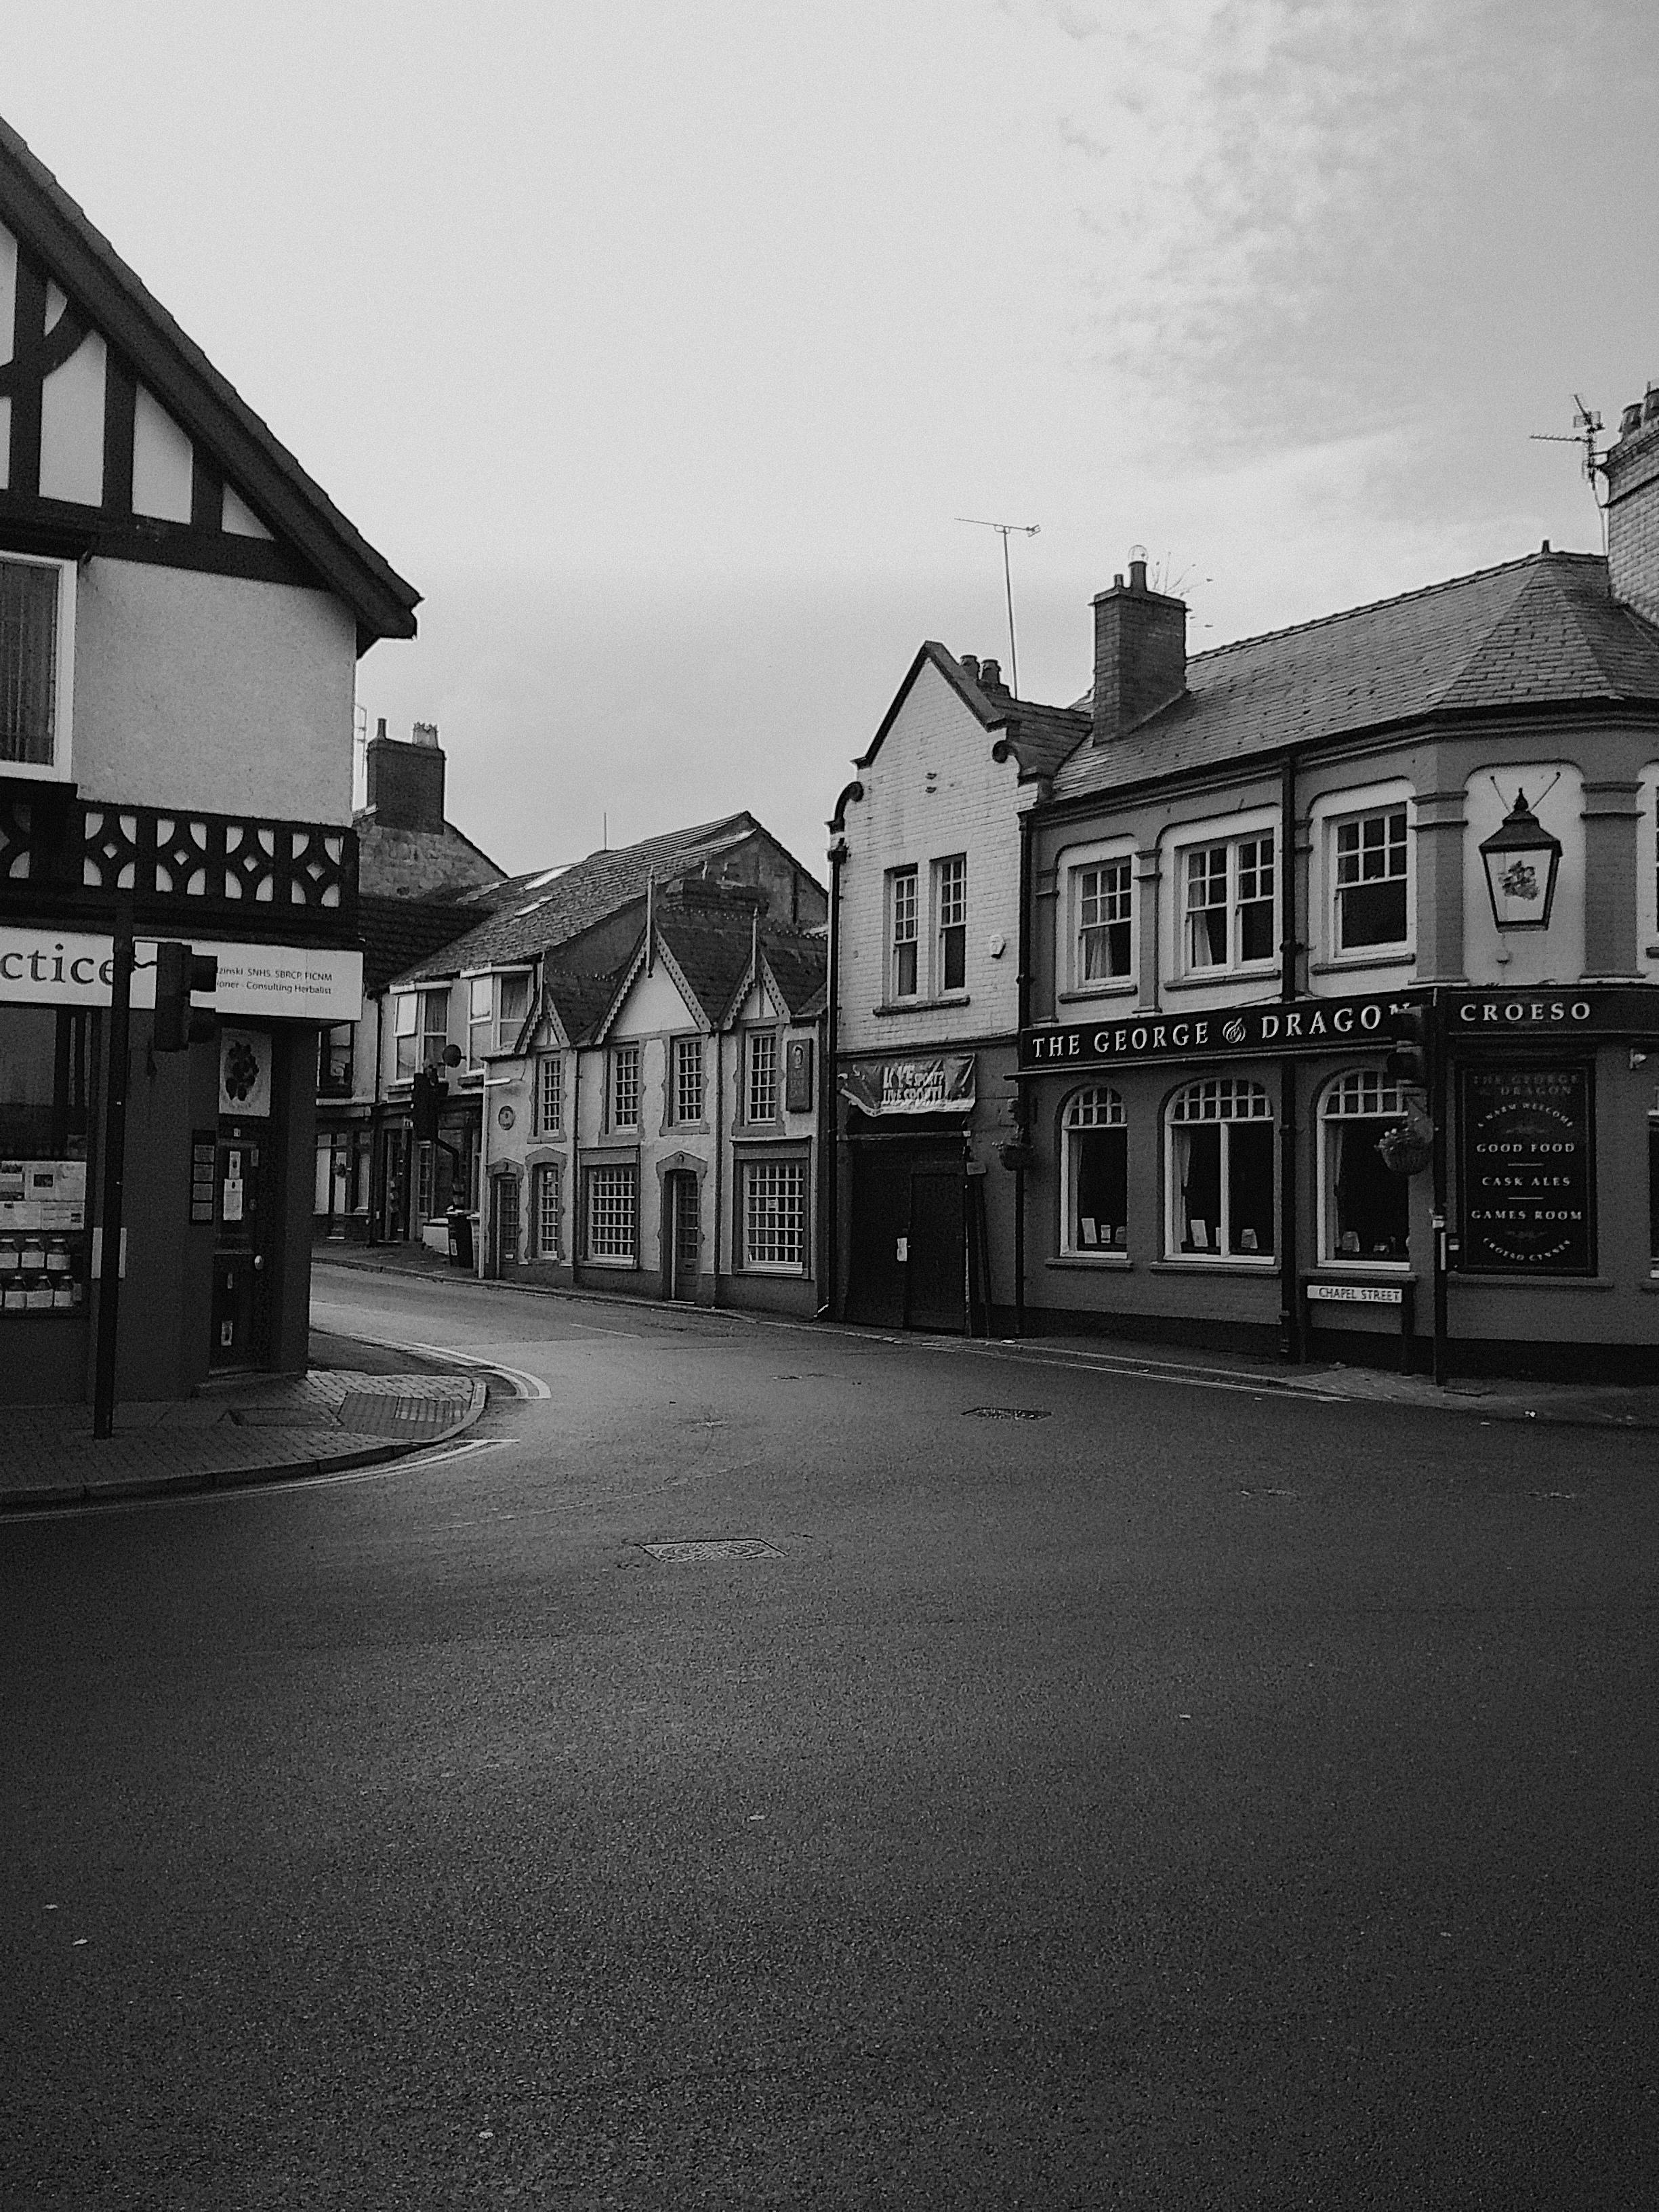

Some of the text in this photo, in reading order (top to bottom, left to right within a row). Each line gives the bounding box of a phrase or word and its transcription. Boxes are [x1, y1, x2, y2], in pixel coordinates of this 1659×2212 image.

[246, 981, 293, 995] Consulting
[1460, 1002, 1591, 1022] CROESO
[1032, 1034, 1080, 1058] THE
[1094, 1021, 1208, 1053] GEORGE
[1261, 1003, 1411, 1038] DRAGO
[1476, 1143, 1575, 1153] GOOD FOOD
[1481, 1176, 1570, 1187] CASK ALES
[1471, 1210, 1582, 1221] GAMES ROOM
[1319, 1287, 1399, 1302] CHAPEL STREET
